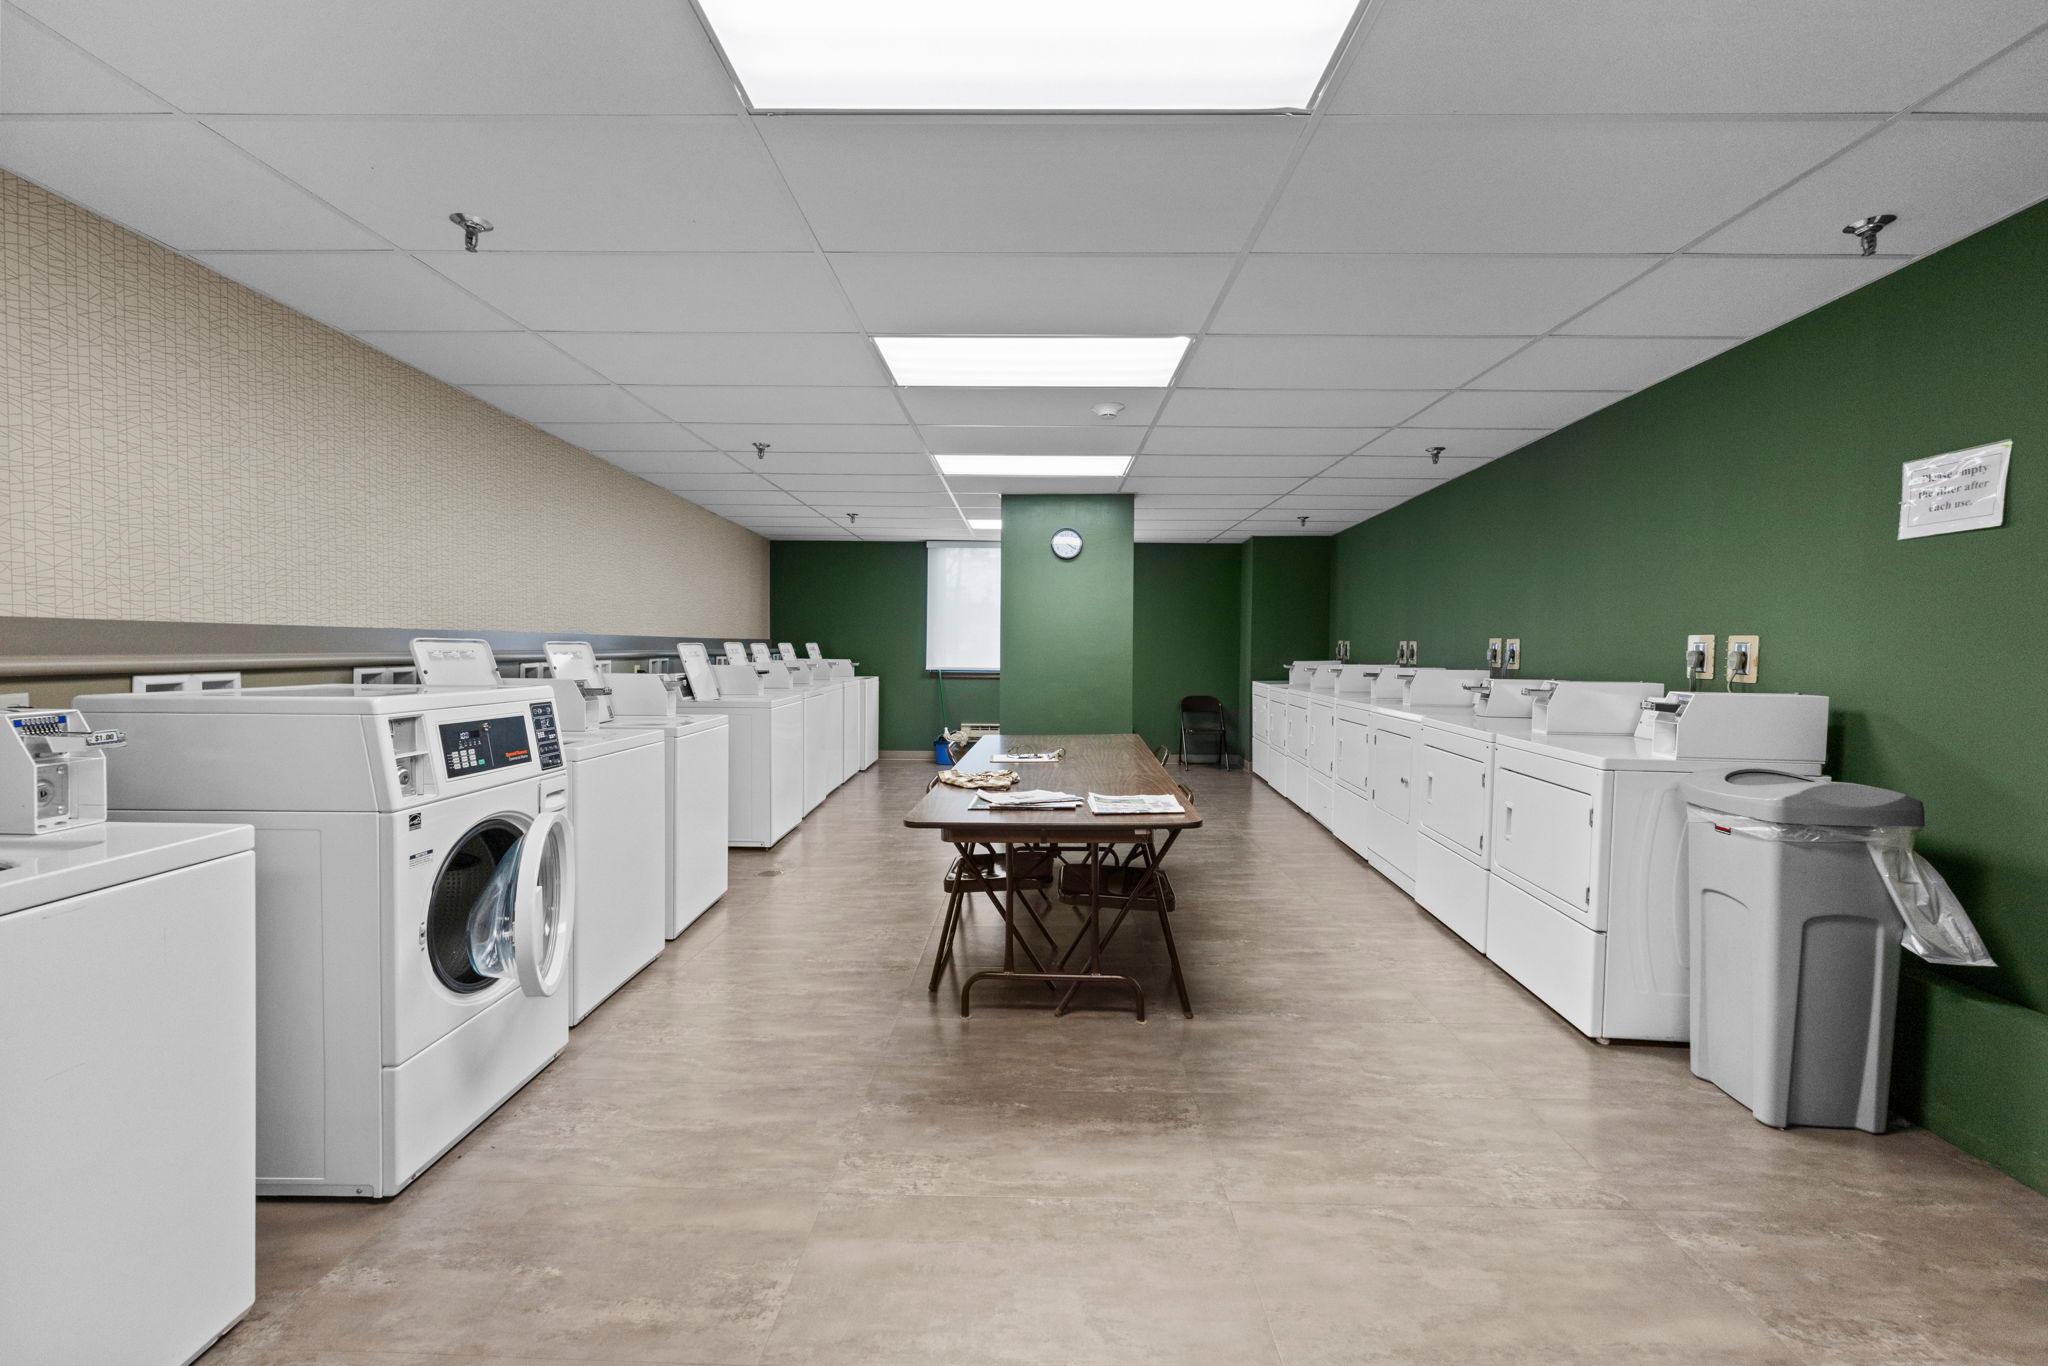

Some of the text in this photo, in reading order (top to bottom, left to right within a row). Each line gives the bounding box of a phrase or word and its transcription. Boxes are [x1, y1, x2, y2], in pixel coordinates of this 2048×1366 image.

[1955, 464, 1989, 477] mpty
[1964, 480, 1990, 491] after
[1928, 501, 1951, 512] each
[95, 733, 114, 742] $1.00
